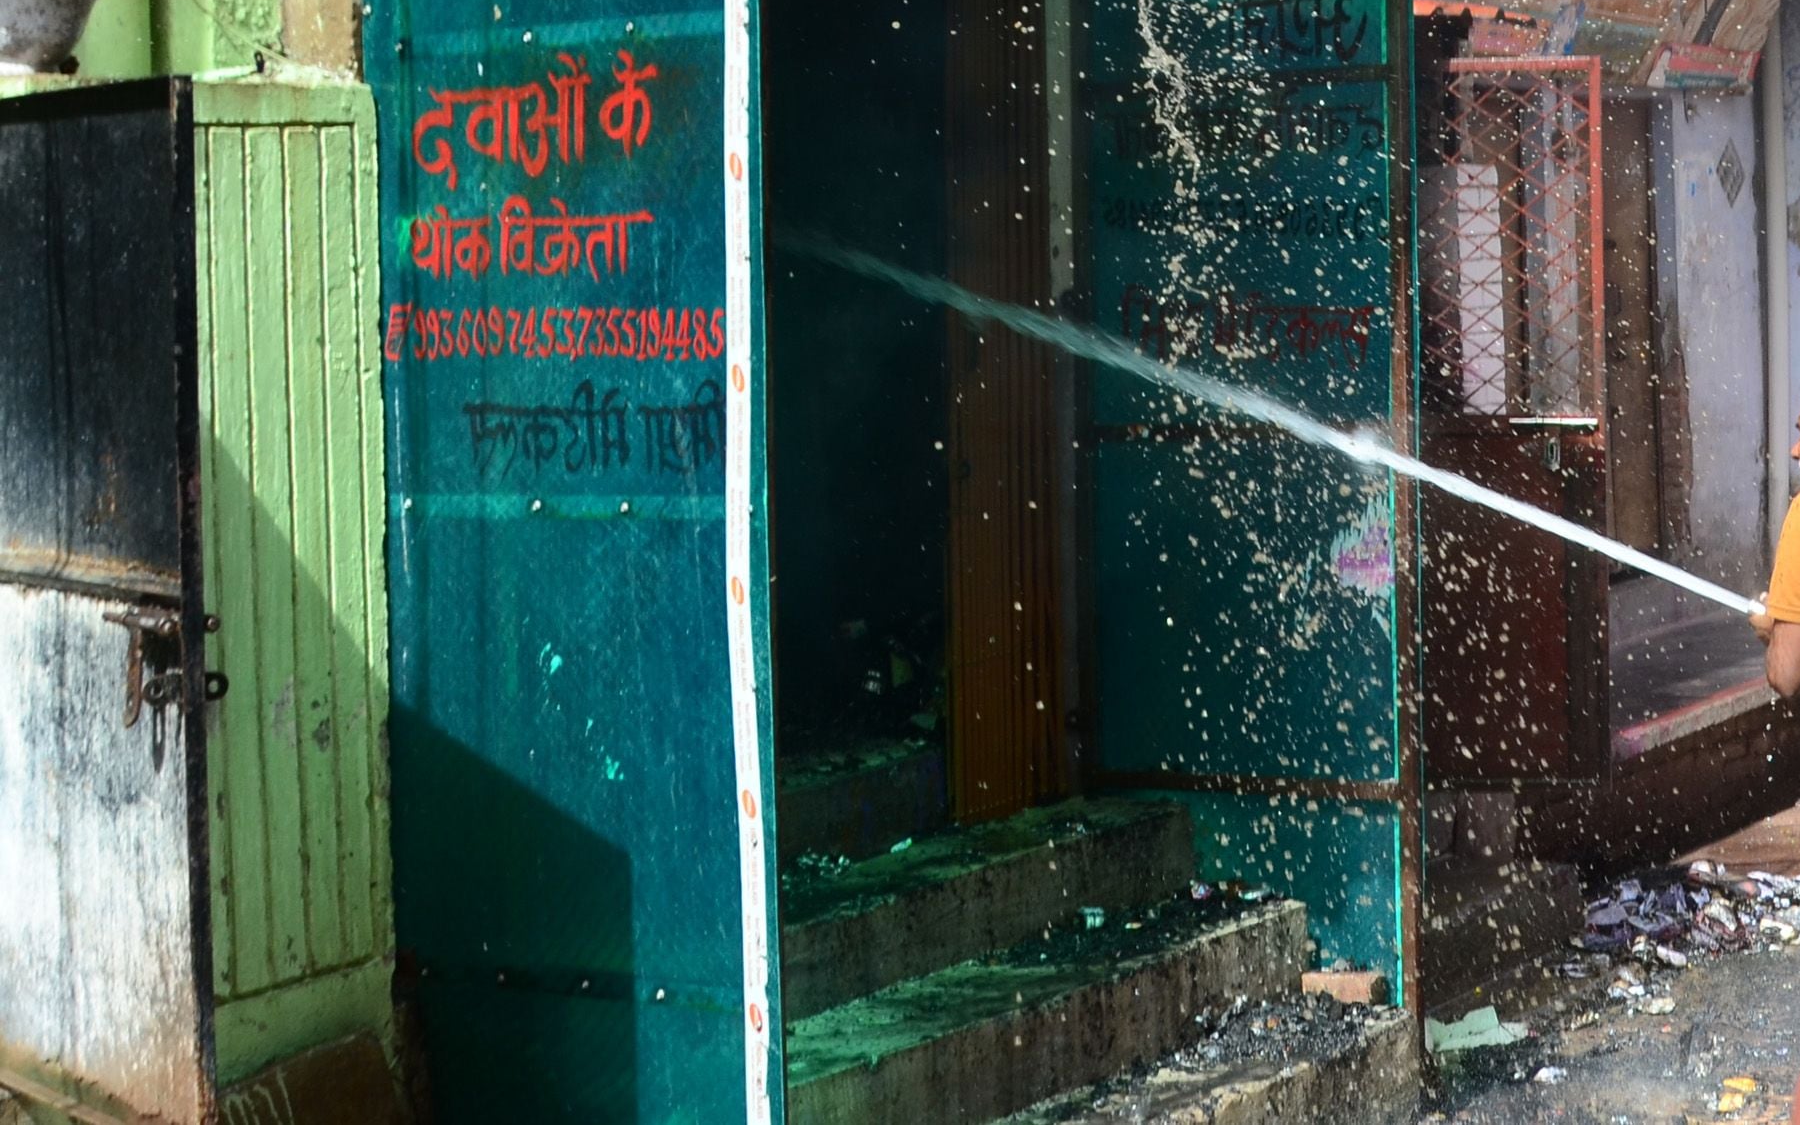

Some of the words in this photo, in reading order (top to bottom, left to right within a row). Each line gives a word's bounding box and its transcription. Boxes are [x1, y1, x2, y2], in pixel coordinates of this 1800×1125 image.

[412, 52, 592, 190] दवाओं
[600, 49, 658, 159] के
[410, 205, 491, 281] थोक
[500, 195, 654, 281] विक्रेता
